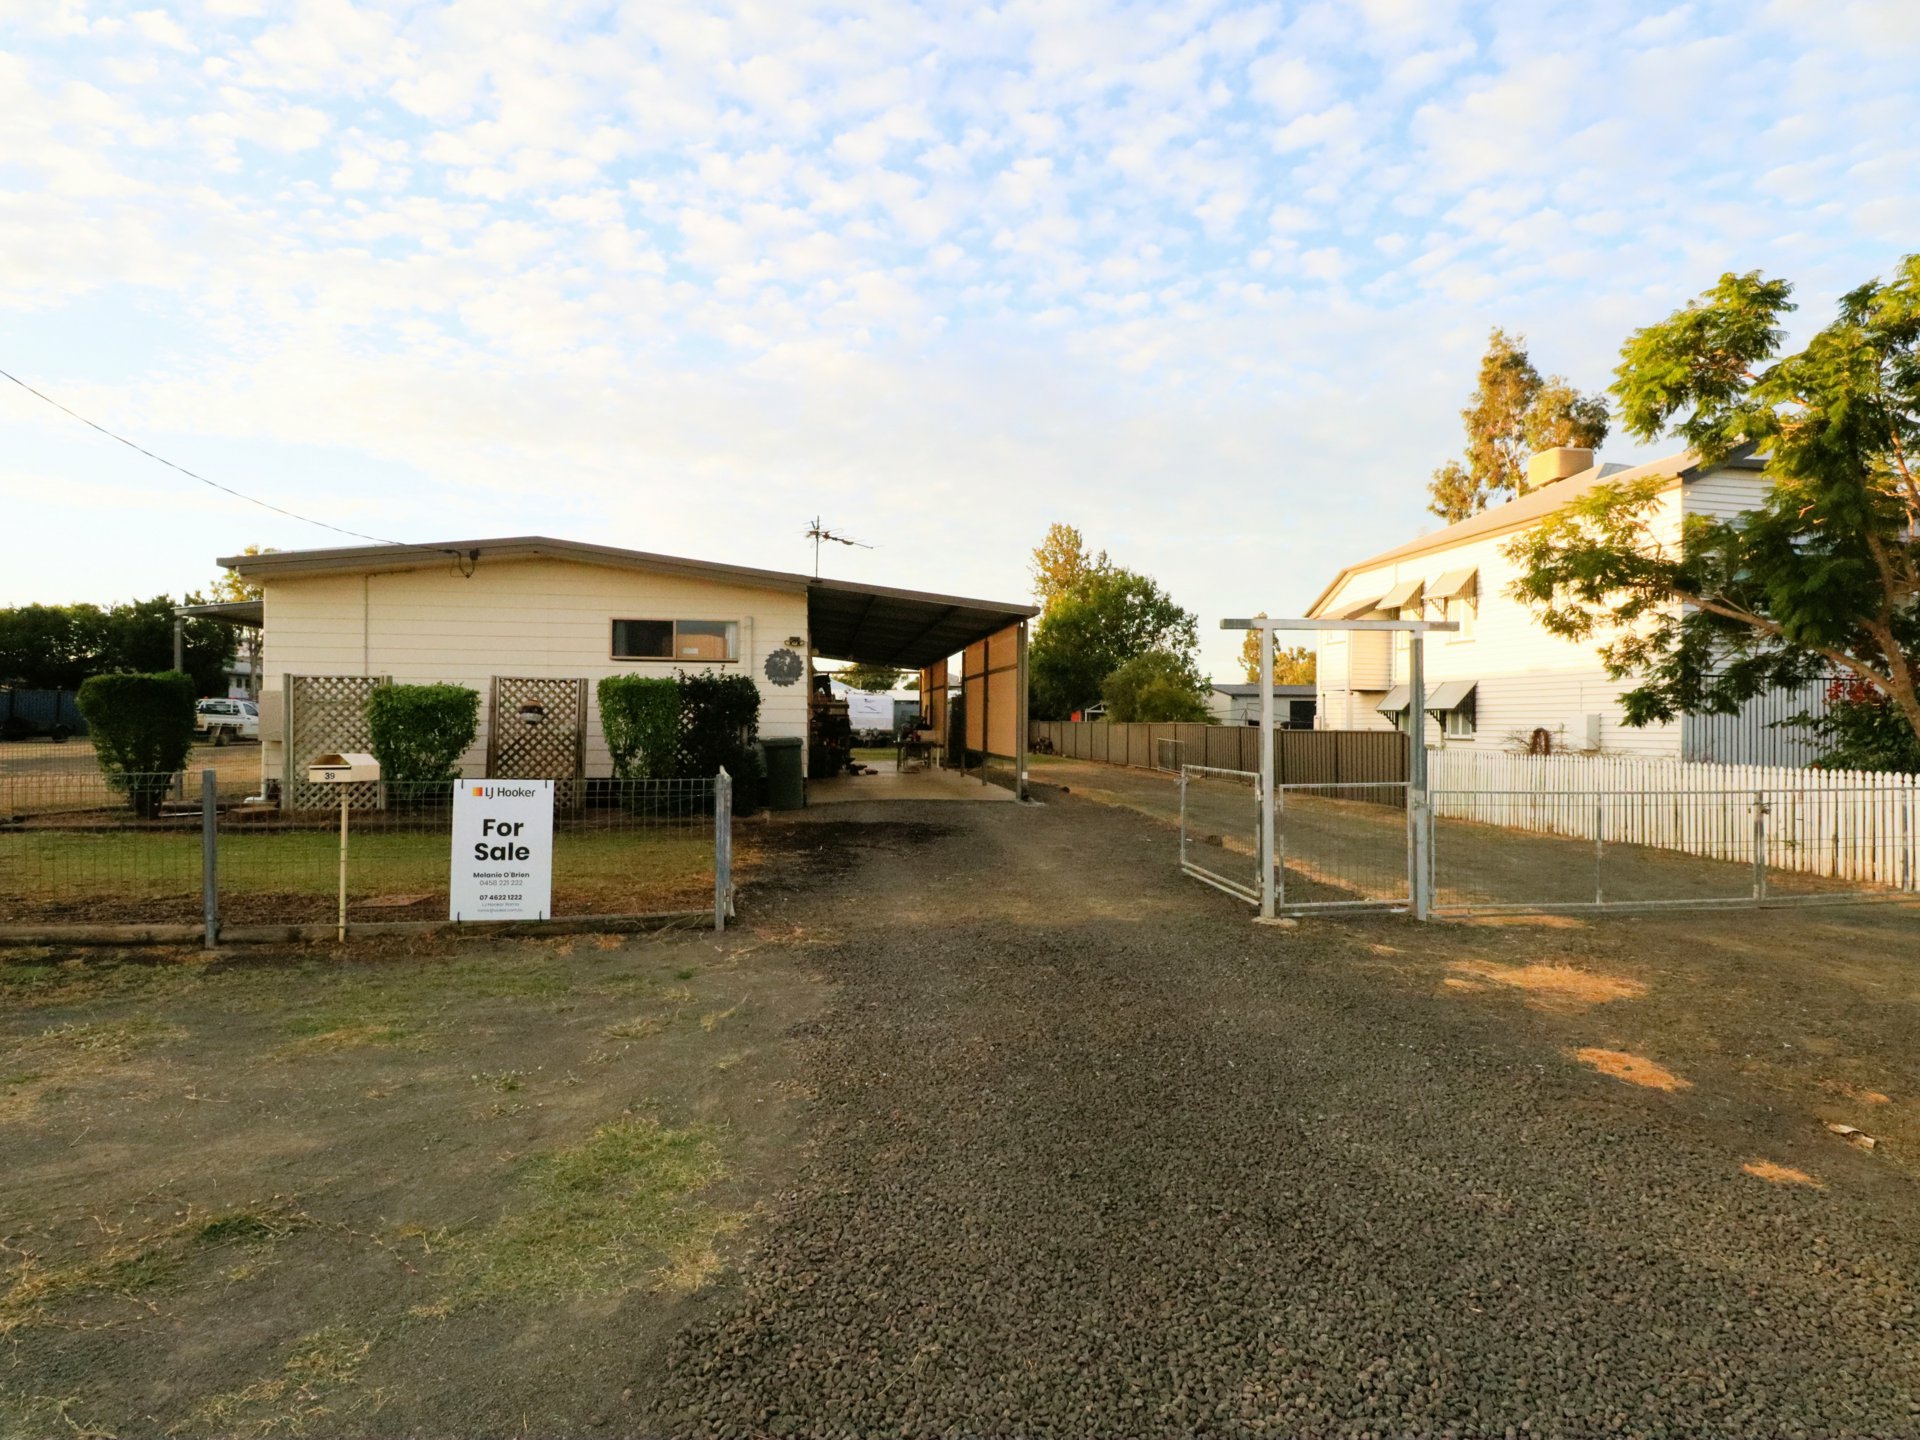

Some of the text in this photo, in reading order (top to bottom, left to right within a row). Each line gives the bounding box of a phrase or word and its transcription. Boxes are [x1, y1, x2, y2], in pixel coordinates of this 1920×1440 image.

[324, 772, 335, 780] 39
[485, 786, 536, 800] LJ Hooker
[482, 818, 524, 837] For
[474, 842, 530, 861] Sale
